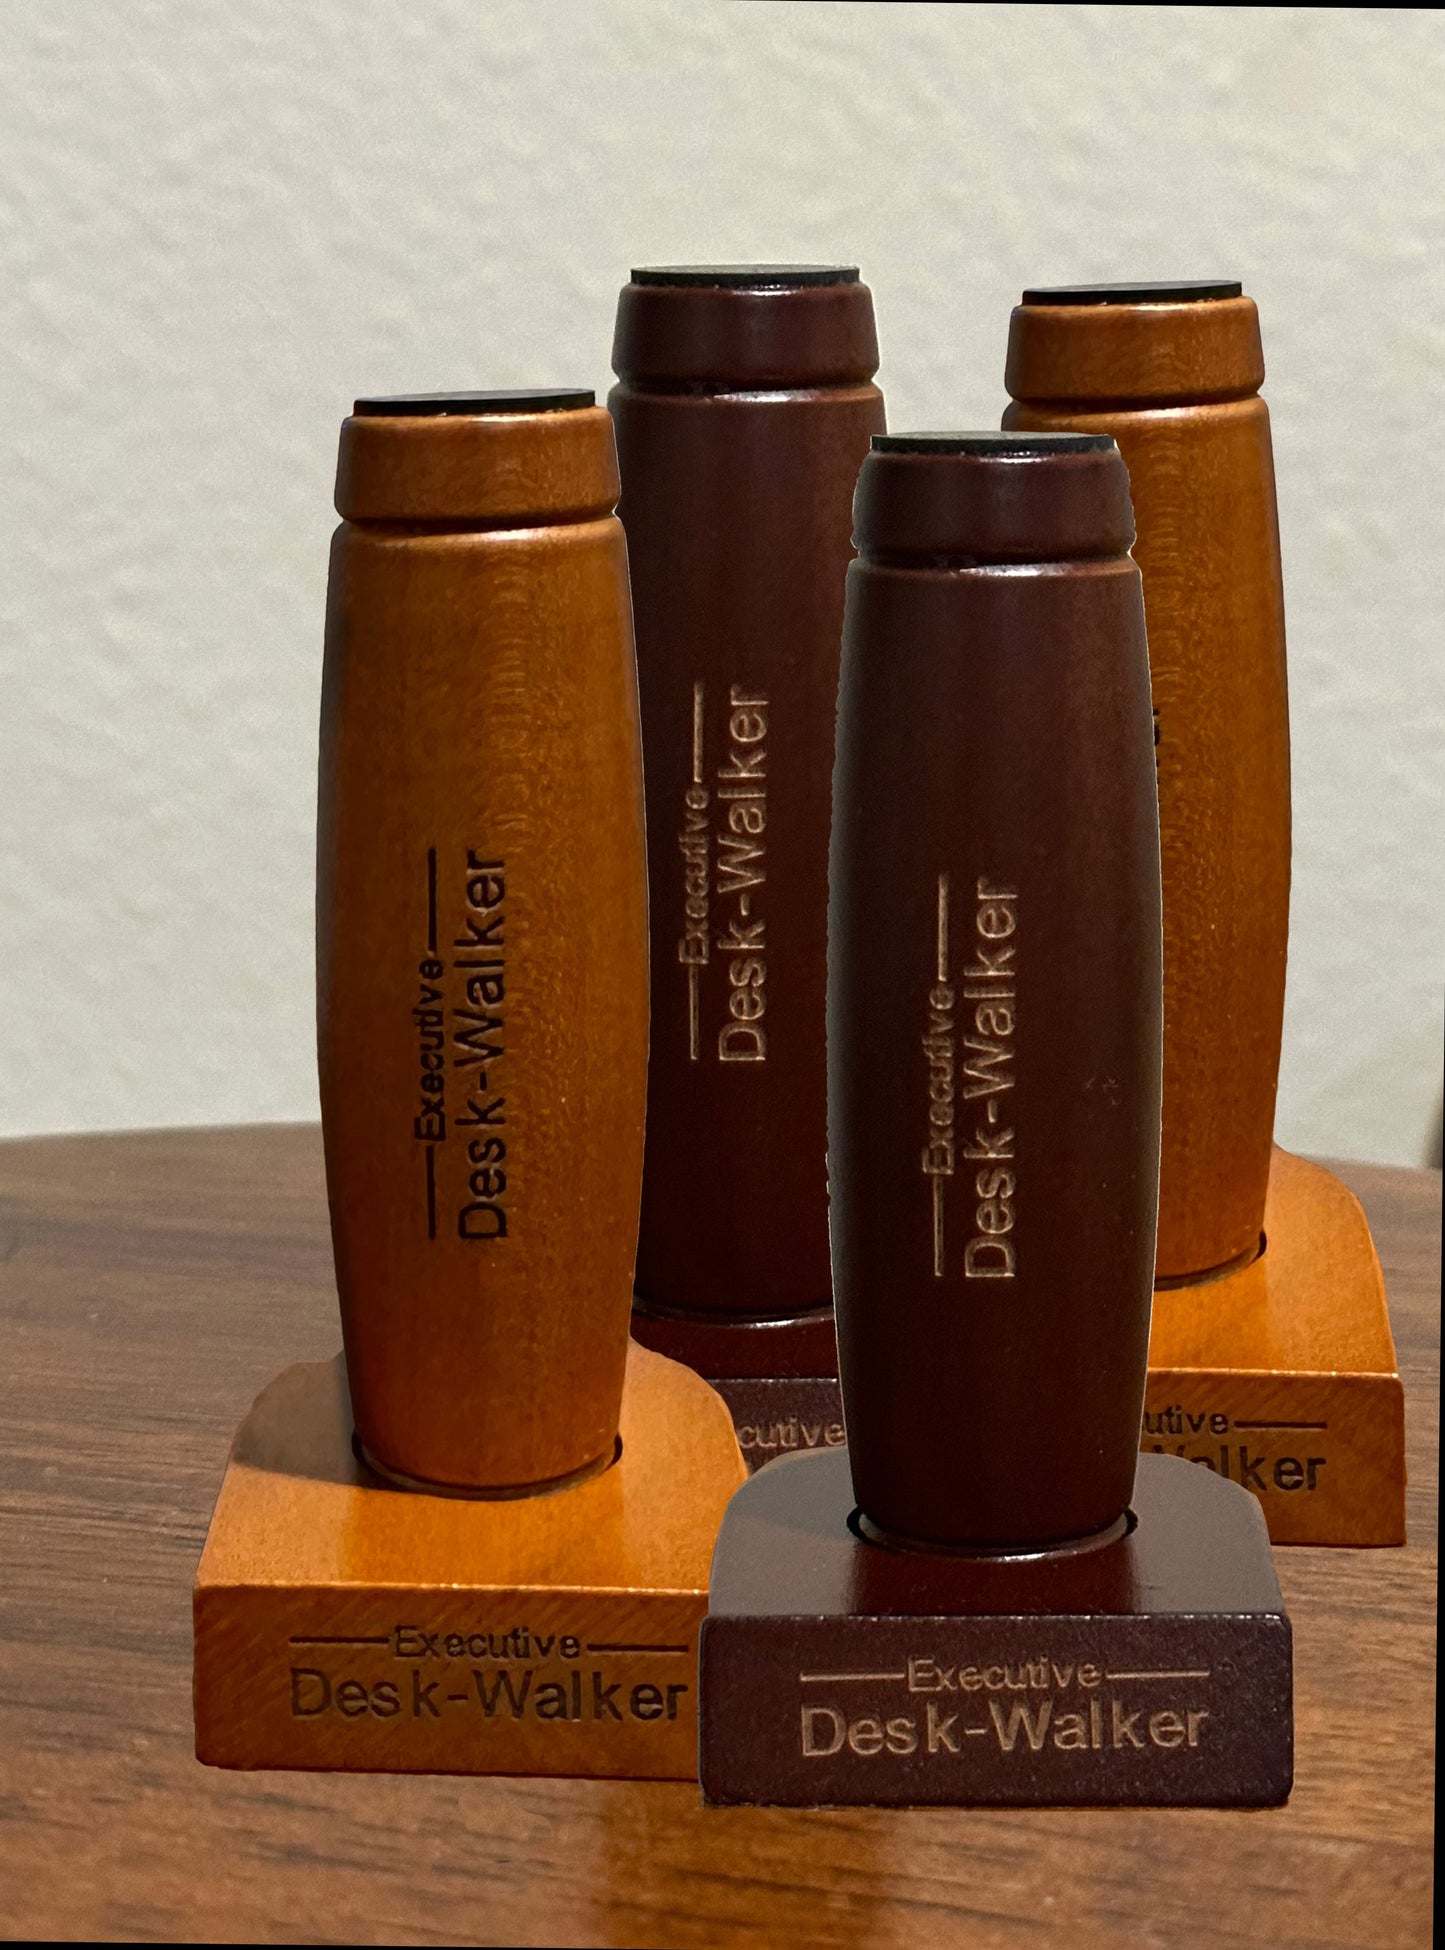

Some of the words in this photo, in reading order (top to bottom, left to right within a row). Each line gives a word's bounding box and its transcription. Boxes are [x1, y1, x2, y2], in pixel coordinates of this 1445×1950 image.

[679, 785, 710, 965] Executive
[717, 682, 768, 1062] Desk-Walker
[414, 958, 446, 1142] Executive
[453, 848, 507, 1240] Desk-Walker
[921, 985, 955, 1175] Executive
[963, 875, 1018, 1279] Desk-Walker
[738, 1414, 847, 1449] cutive
[1142, 1404, 1230, 1436] utive
[289, 1667, 689, 1722] Desk-Walker
[393, 1624, 581, 1660] Executive
[906, 1655, 1101, 1693] Executive
[800, 1698, 1209, 1757] Desk-Walker
